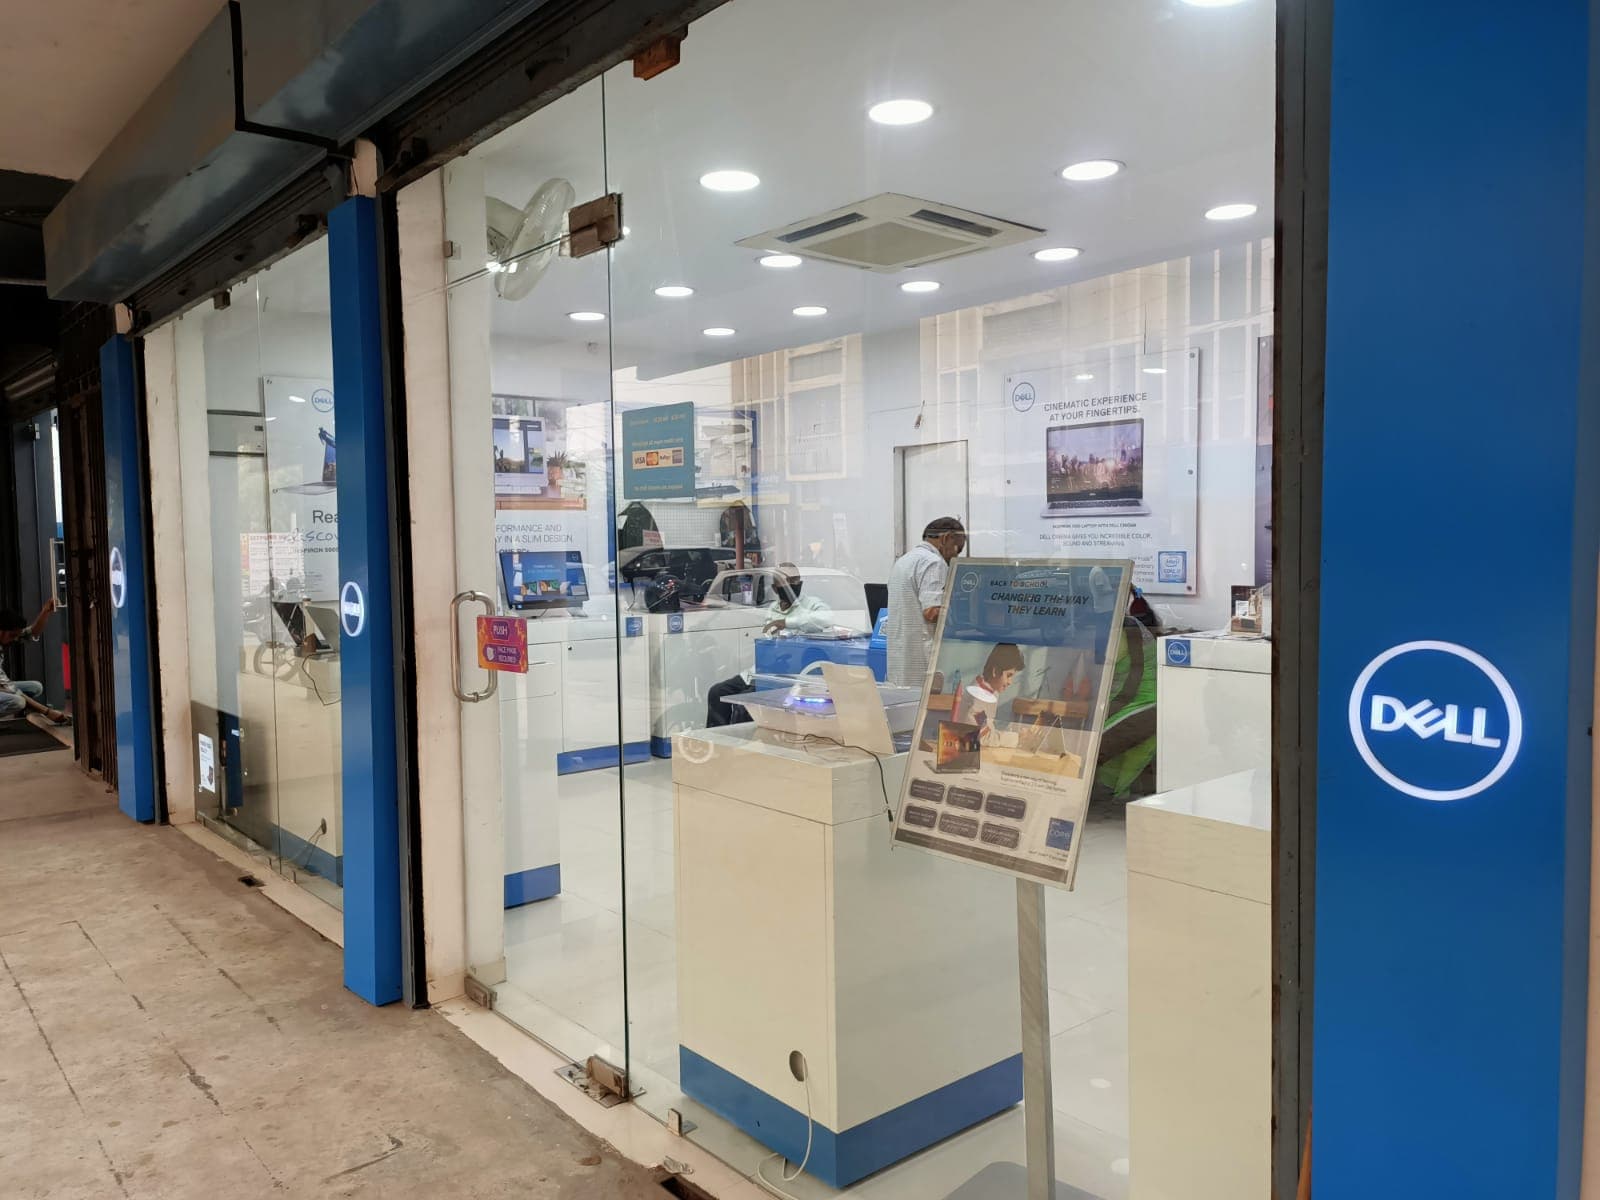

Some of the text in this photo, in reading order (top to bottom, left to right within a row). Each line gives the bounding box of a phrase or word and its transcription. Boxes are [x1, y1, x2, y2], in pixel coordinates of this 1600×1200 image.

[1015, 393, 1032, 402] DELL
[1044, 393, 1147, 412] CINEMATIC EXPERIENCE
[1049, 413, 1059, 421] AT
[1061, 410, 1085, 420] YOUR
[634, 456, 645, 464] VISA
[544, 524, 562, 532] AND
[522, 535, 542, 543] SLIM
[543, 534, 573, 543] DESIGN
[990, 592, 1041, 603] CHANGING
[1044, 594, 1064, 604] THE
[1007, 605, 1067, 617] THEY LEARN
[493, 625, 508, 636] PUSH
[1370, 694, 1501, 749] DELL
